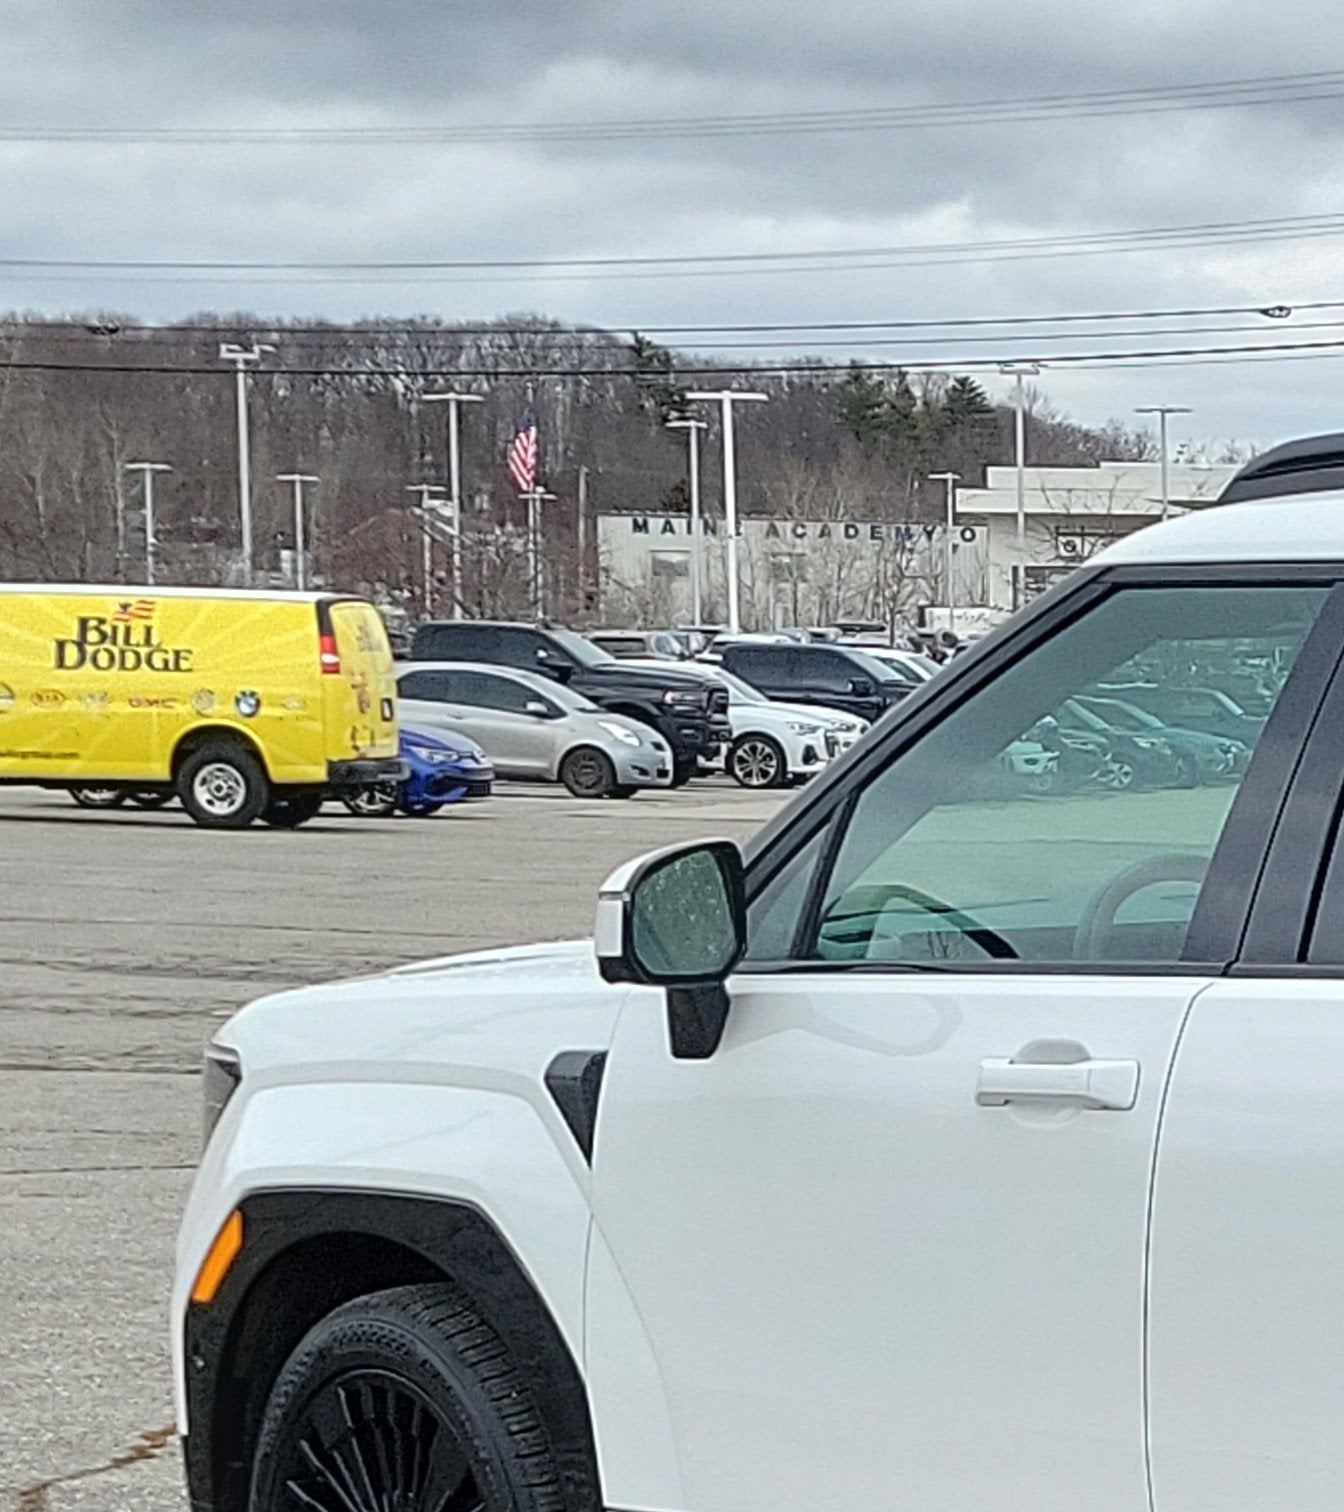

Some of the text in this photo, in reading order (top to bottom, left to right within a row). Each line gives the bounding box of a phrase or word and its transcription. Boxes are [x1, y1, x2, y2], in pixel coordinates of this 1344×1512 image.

[766, 521, 937, 543] ACADEMY
[78, 615, 162, 648] BILL
[54, 638, 194, 672] DODGE
